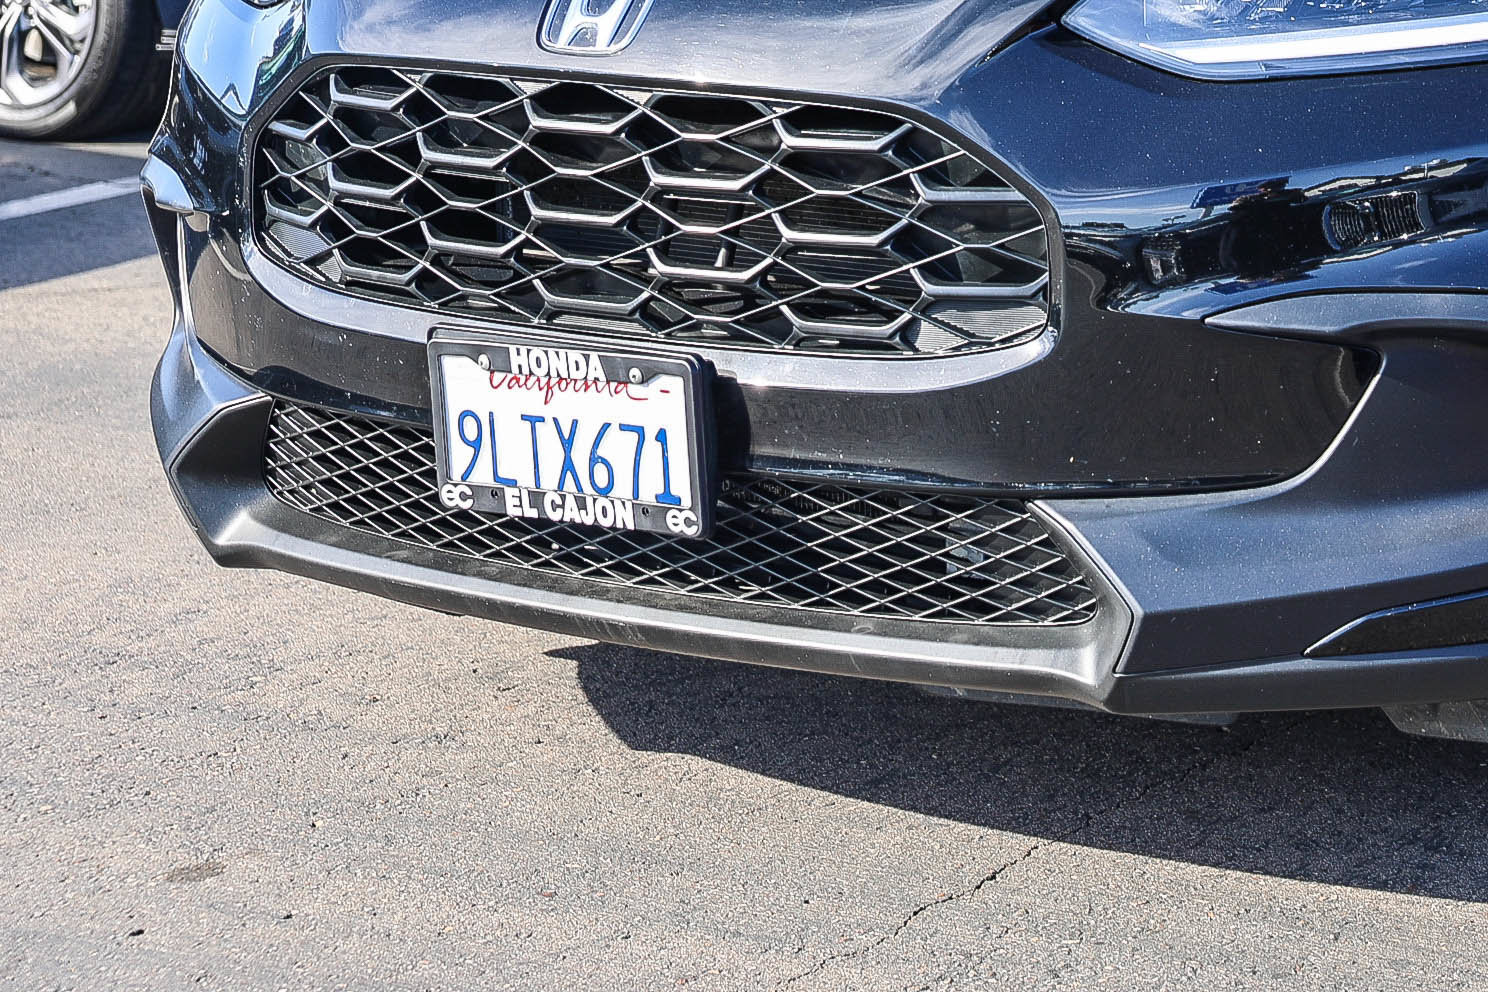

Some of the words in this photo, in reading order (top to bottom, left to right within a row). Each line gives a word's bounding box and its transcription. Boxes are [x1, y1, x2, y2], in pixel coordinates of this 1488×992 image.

[508, 346, 608, 383] HONDA
[457, 410, 682, 506] 9LTX671
[504, 486, 539, 519] EL
[543, 490, 636, 530] CAJON
